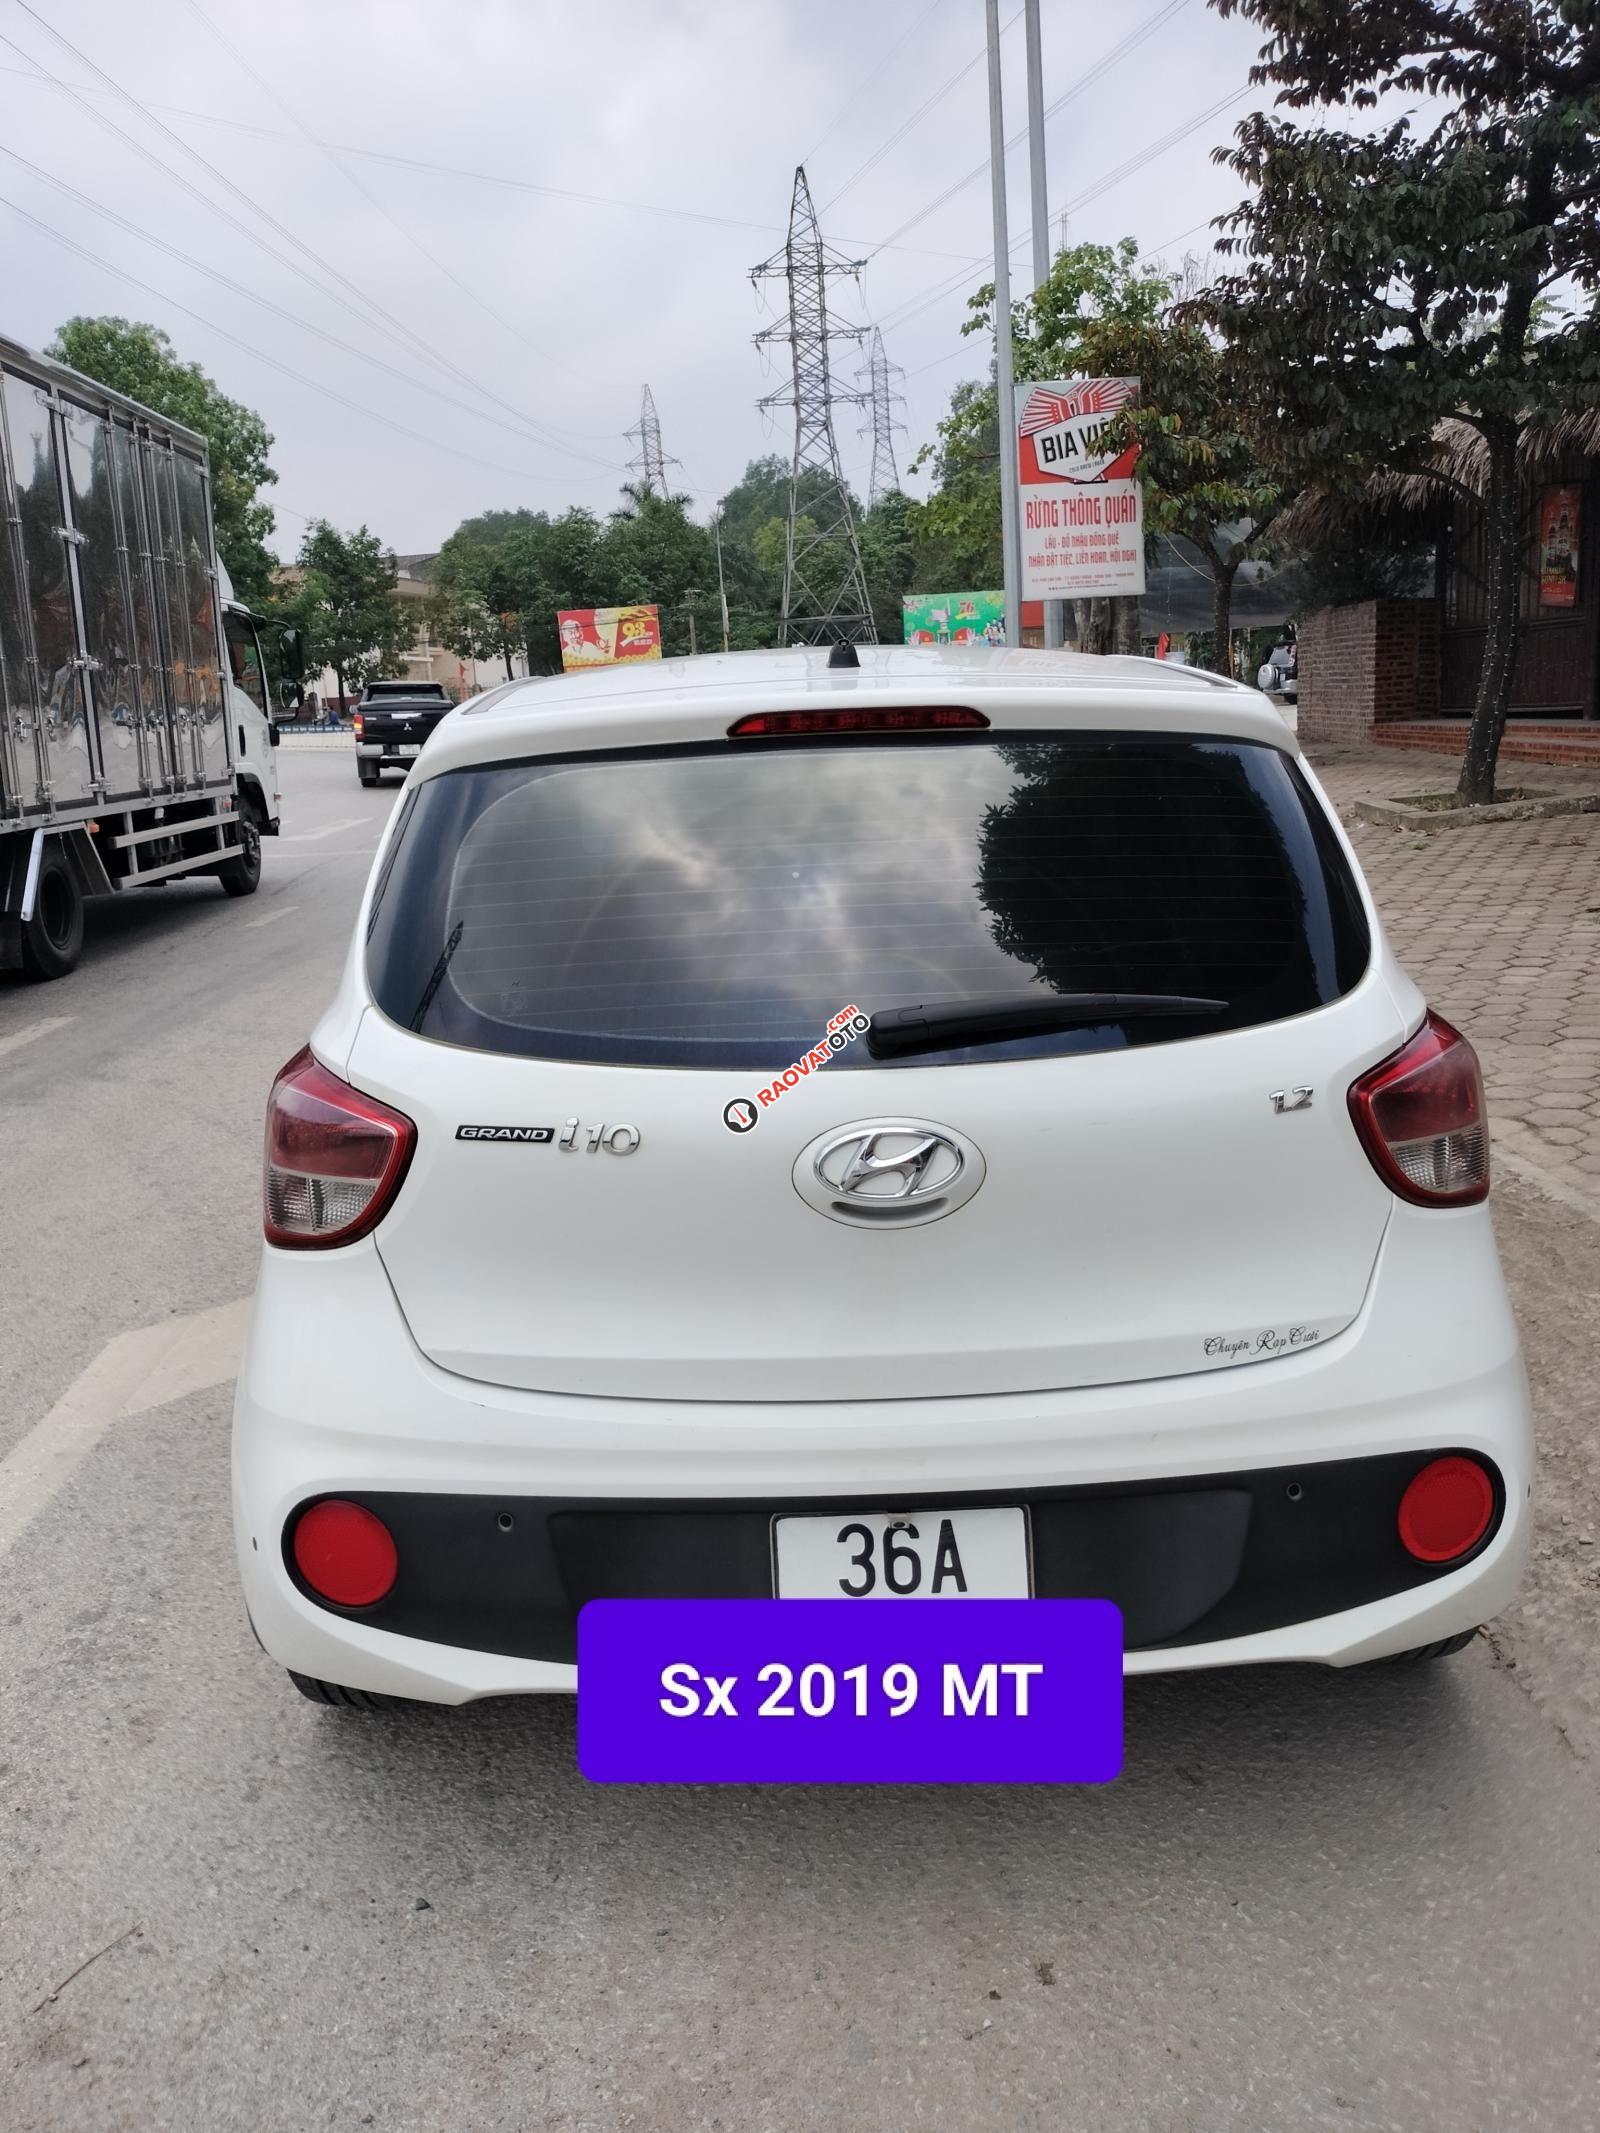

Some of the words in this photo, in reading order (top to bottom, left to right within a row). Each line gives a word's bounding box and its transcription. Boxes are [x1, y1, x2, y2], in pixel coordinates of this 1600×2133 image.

[1041, 431, 1079, 464] BIA
[1026, 494, 1058, 529] RỪNG
[1062, 491, 1101, 526] THÔNG
[1269, 1086, 1313, 1114] 1.2
[460, 1127, 549, 1140] GRAND
[559, 1117, 641, 1157] i10
[837, 1519, 968, 1597] 36A
